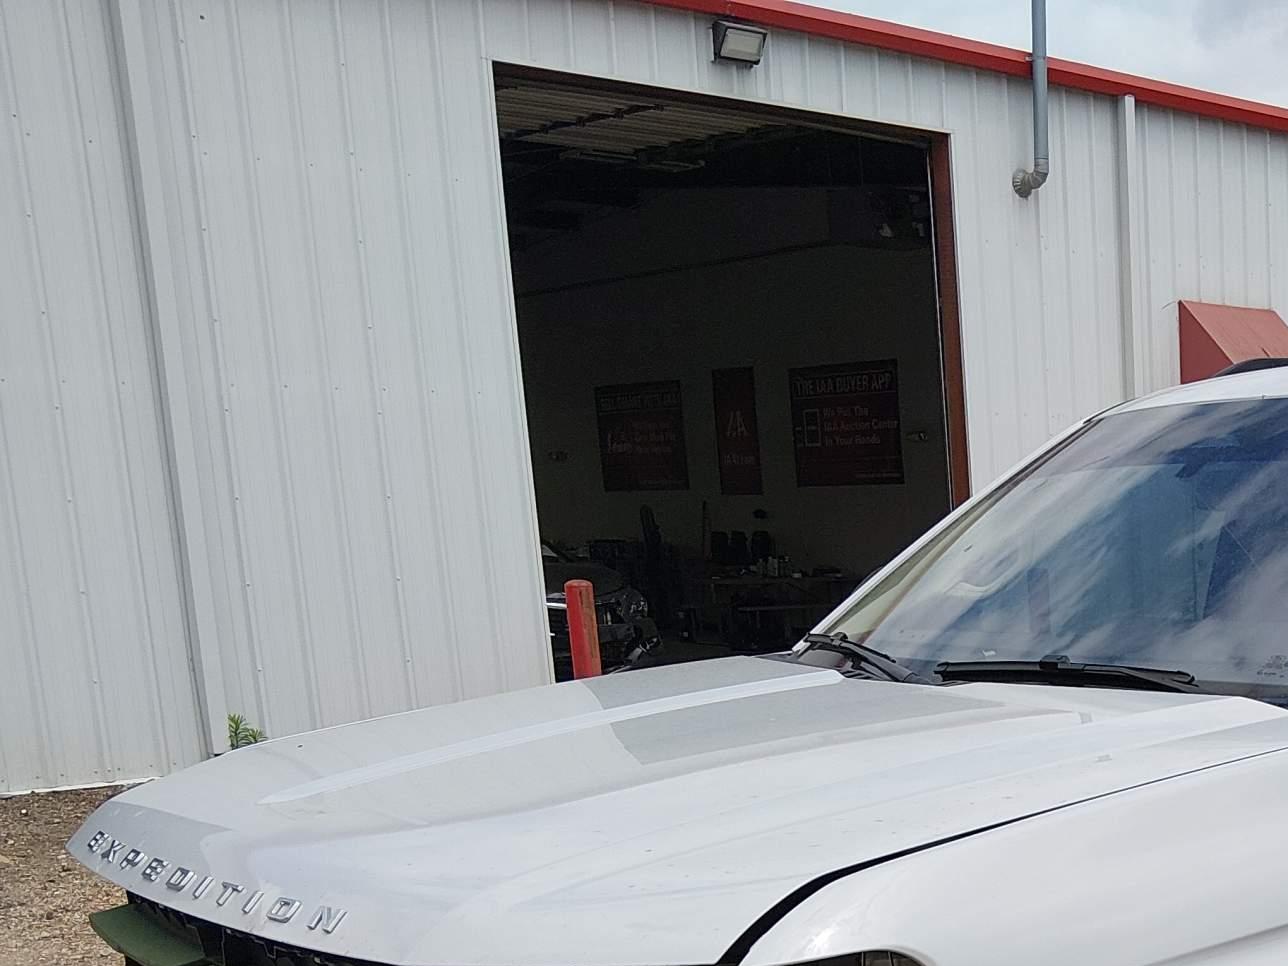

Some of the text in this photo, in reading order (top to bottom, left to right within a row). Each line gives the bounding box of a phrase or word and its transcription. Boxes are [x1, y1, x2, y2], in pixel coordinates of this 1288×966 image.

[835, 374, 870, 393] BUYER
[871, 371, 892, 390] APP
[87, 830, 348, 934] EXPEDITION
